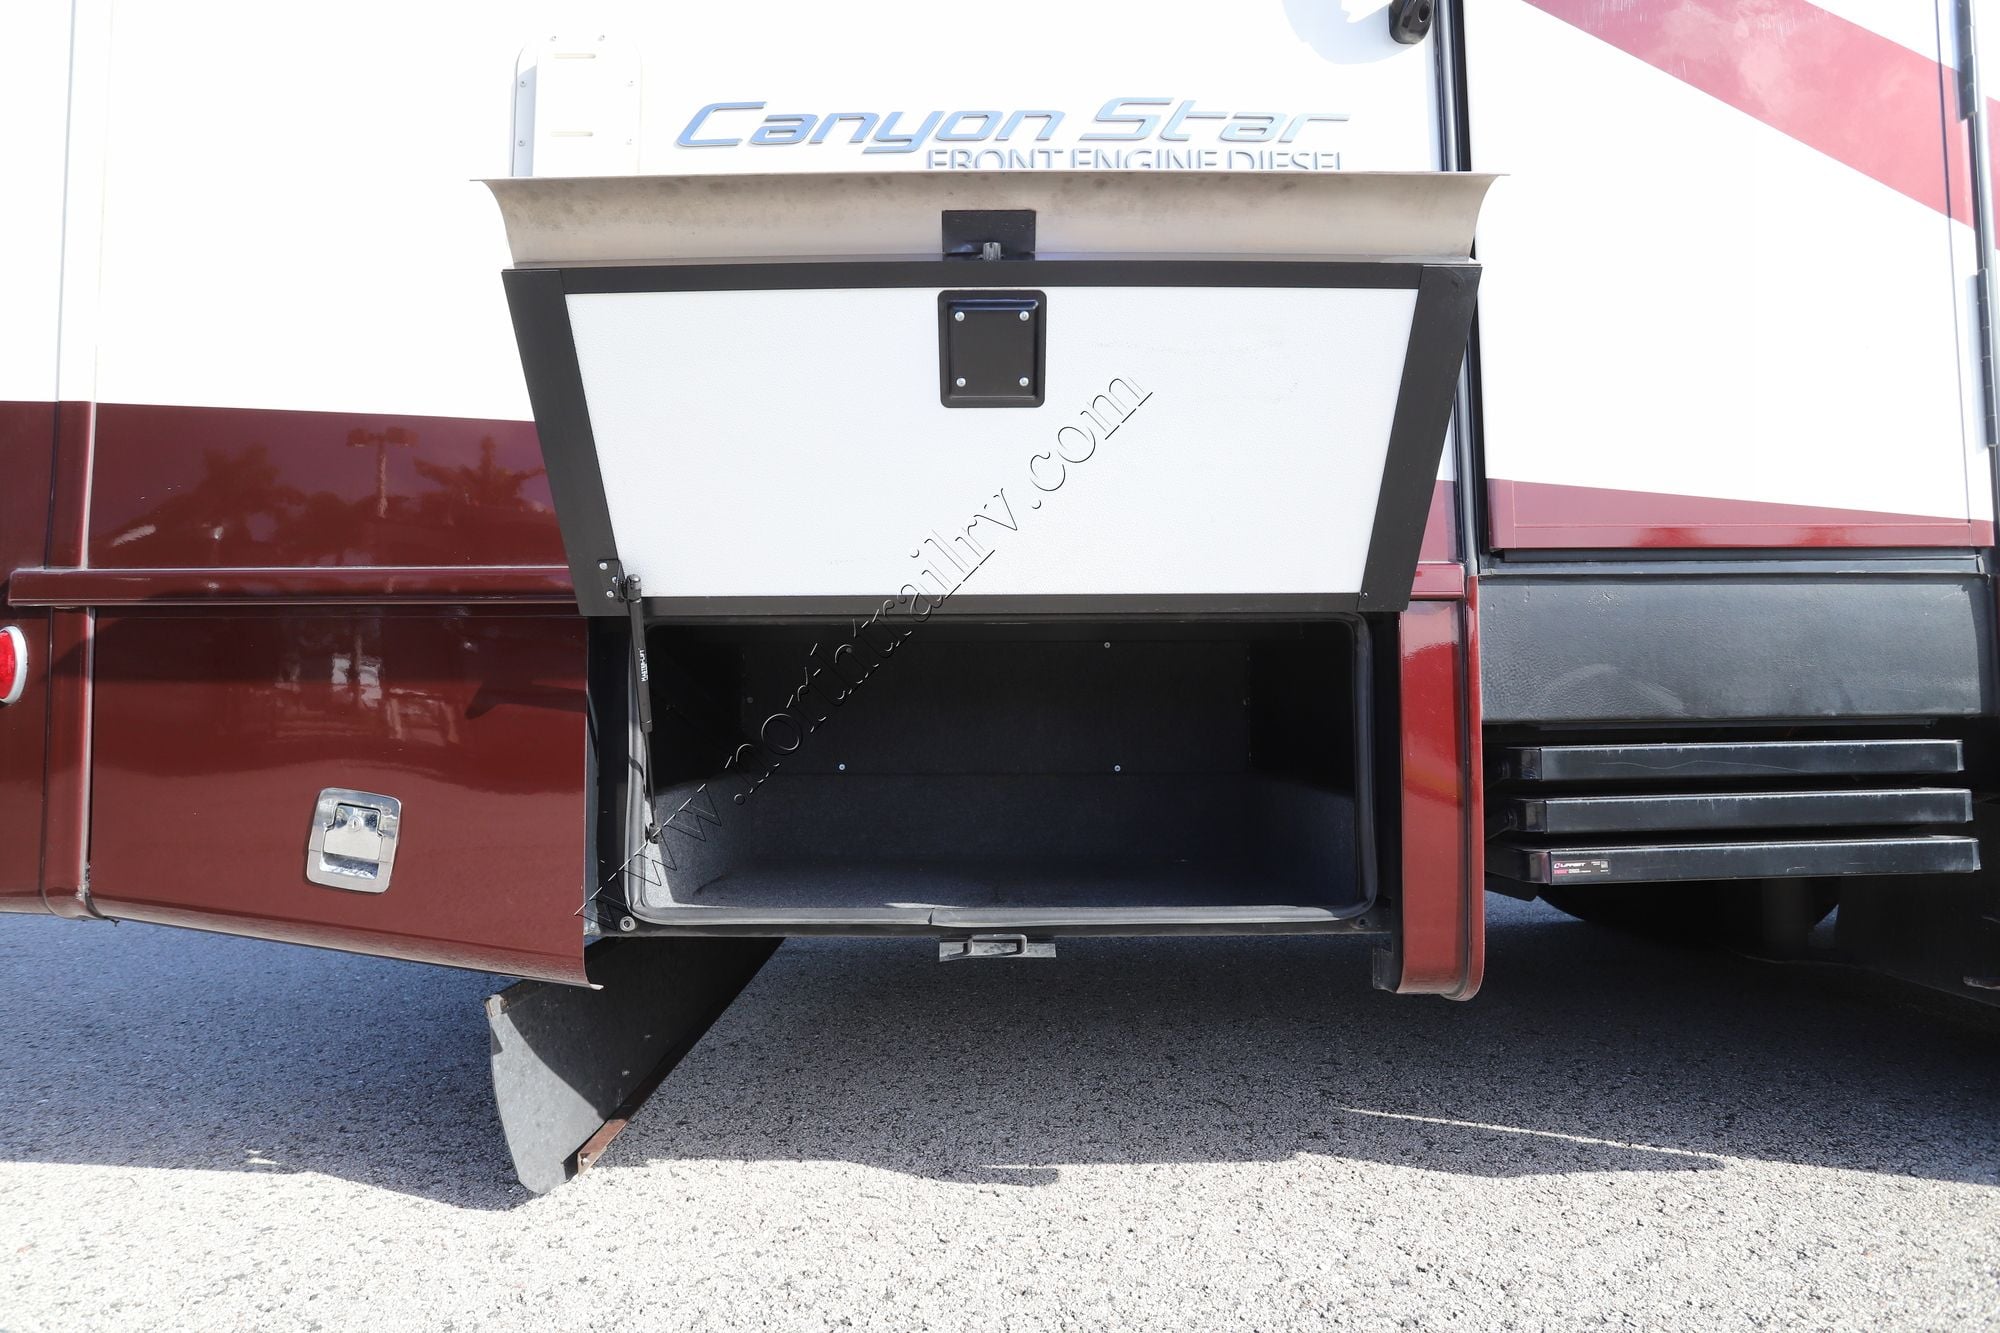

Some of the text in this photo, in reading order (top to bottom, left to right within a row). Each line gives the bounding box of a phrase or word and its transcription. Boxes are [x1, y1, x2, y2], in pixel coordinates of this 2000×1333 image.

[676, 97, 1351, 155] Canyon Star
[928, 149, 1063, 170] FRONT
[1071, 149, 1219, 170] ENGINE
